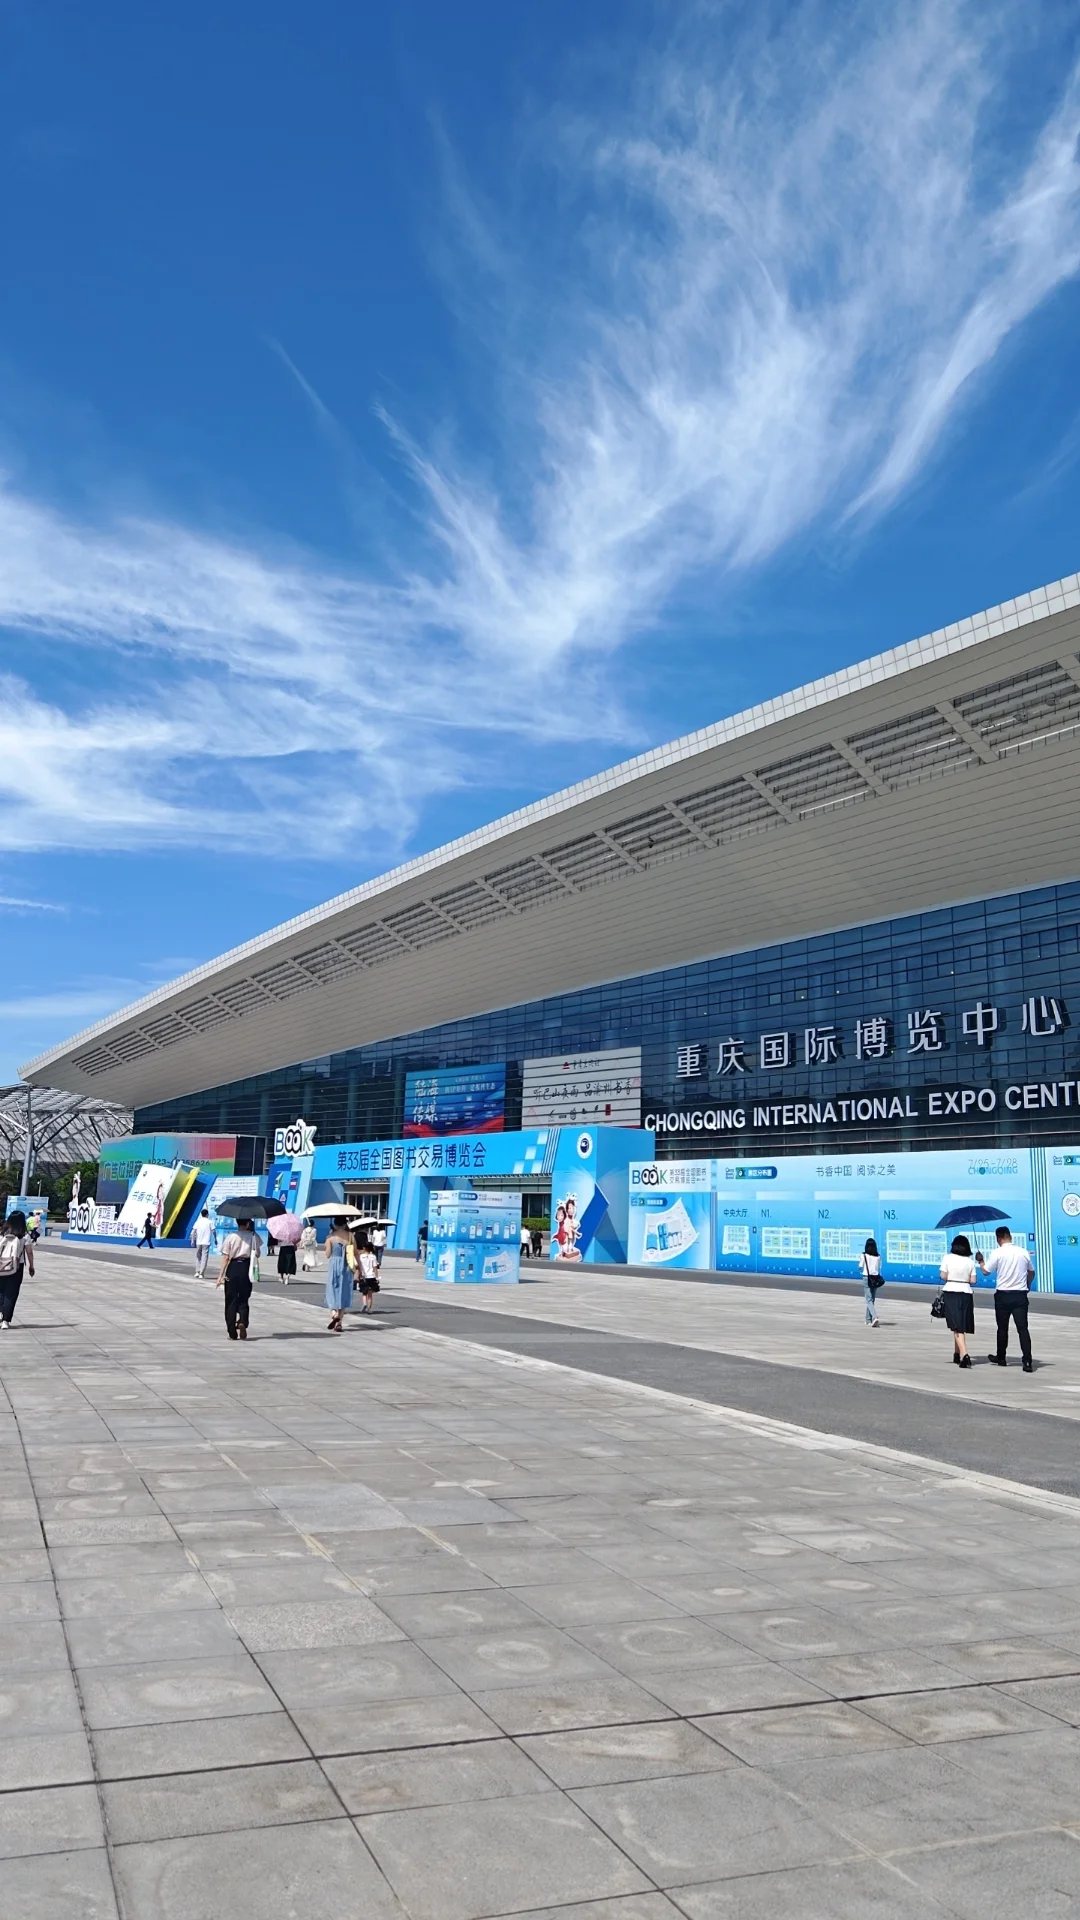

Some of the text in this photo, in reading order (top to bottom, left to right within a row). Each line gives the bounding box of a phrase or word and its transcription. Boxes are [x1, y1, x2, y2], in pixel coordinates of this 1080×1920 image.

[676, 996, 1063, 1078] 重庆国际博览中心
[644, 1108, 745, 1132] CHONGQING
[753, 1095, 919, 1127] INTERNATIONAL
[928, 1088, 996, 1116] EXPO
[275, 1128, 313, 1154] BOOK
[337, 1141, 486, 1171] 第33届全国图书交易博览会
[632, 1167, 668, 1186] BOOK
[815, 1164, 896, 1177] 书香中国 阅读之美
[70, 1206, 97, 1233] BOOK
[818, 1209, 831, 1219] N2.
[884, 1210, 898, 1220] N3.
